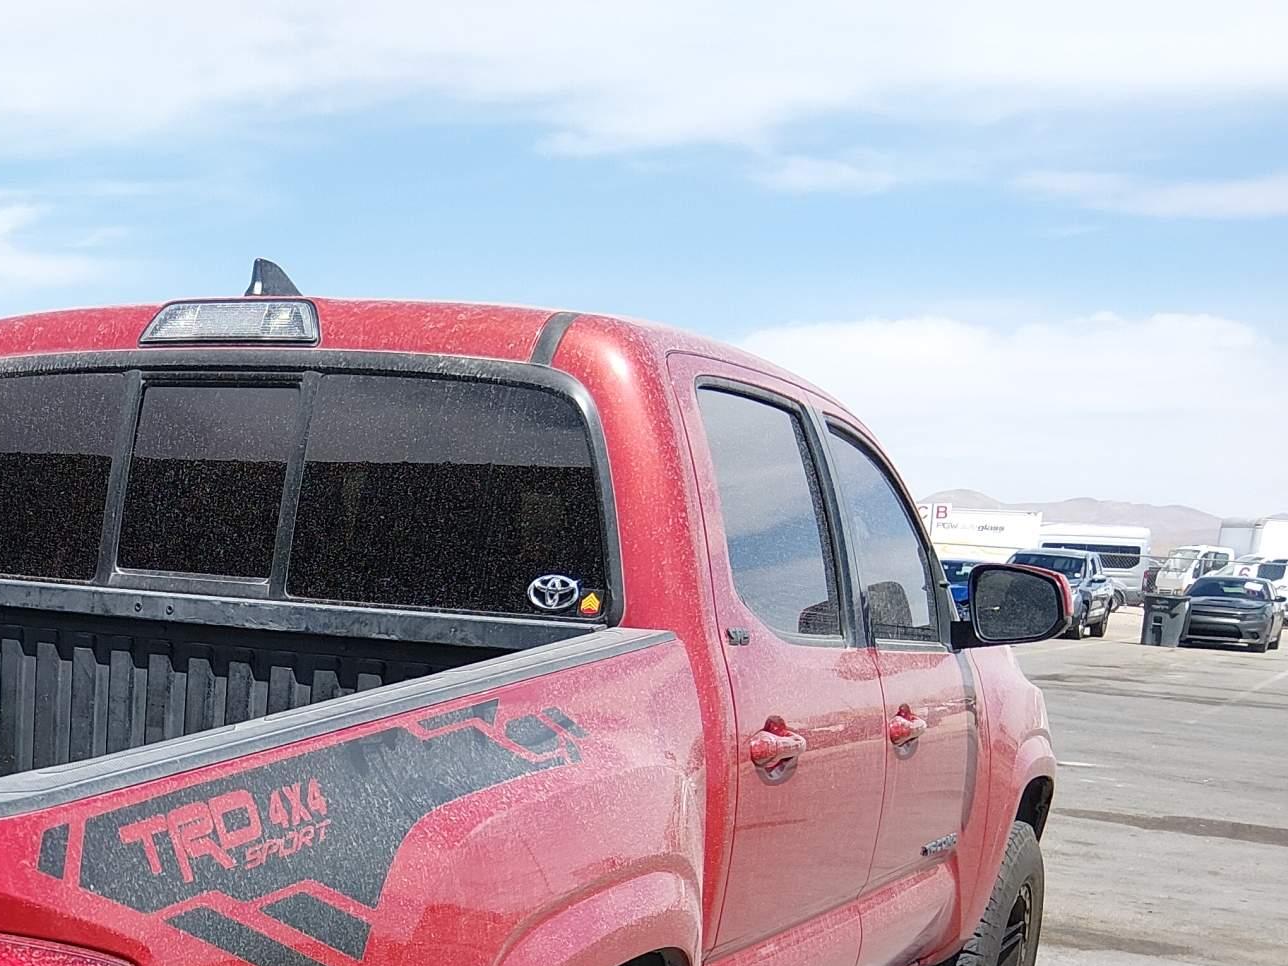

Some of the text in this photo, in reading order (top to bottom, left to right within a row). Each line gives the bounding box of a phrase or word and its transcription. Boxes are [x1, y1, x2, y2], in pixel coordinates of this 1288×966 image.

[936, 505, 948, 519] B
[119, 789, 263, 884] TRD
[243, 818, 332, 870] SPORT
